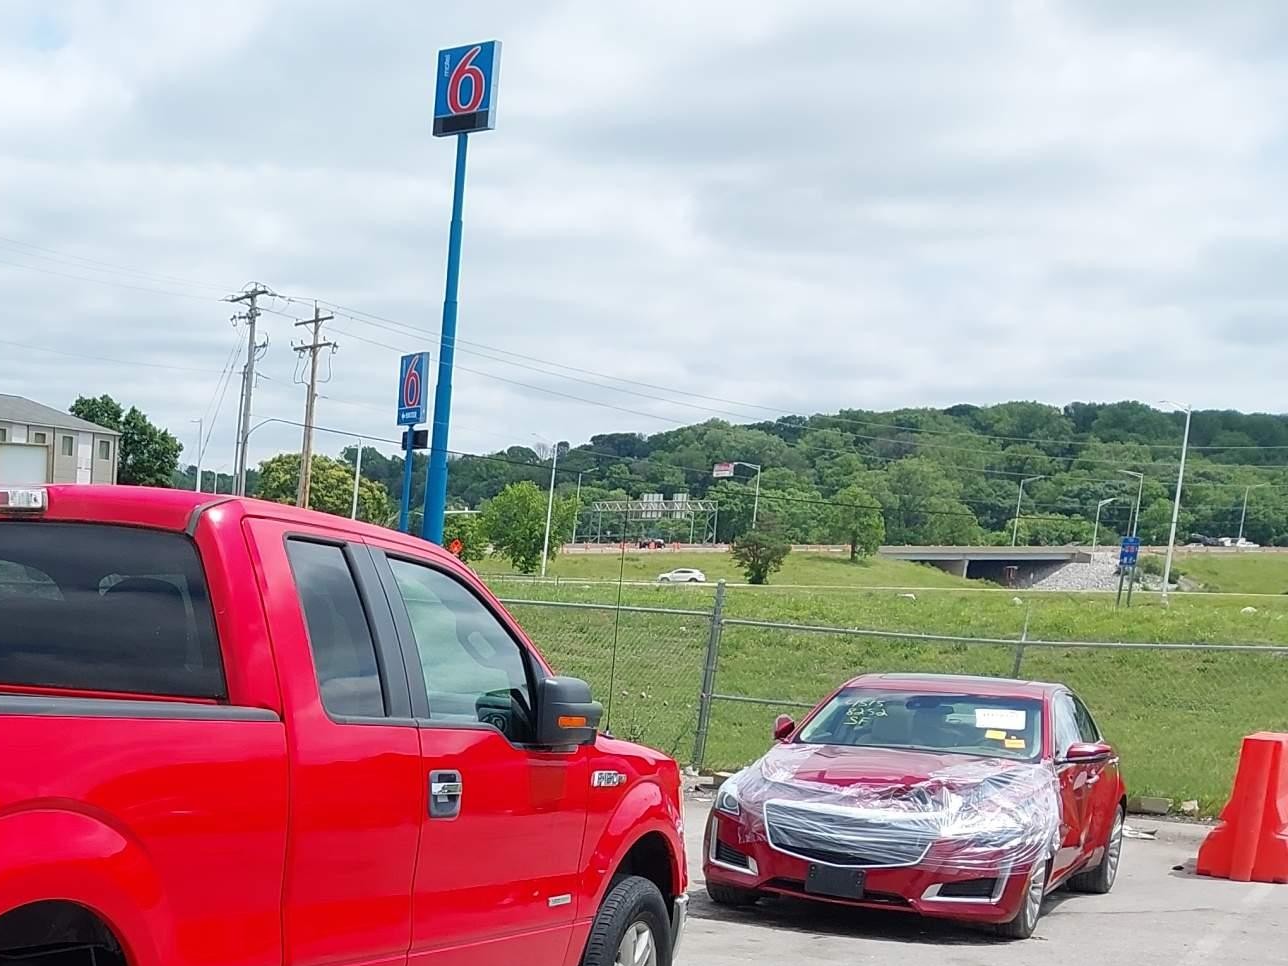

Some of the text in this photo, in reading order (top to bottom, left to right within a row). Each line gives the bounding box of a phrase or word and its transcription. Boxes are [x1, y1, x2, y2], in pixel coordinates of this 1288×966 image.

[447, 45, 486, 115] 6
[403, 354, 421, 408] 6
[845, 707, 888, 717] 8252
